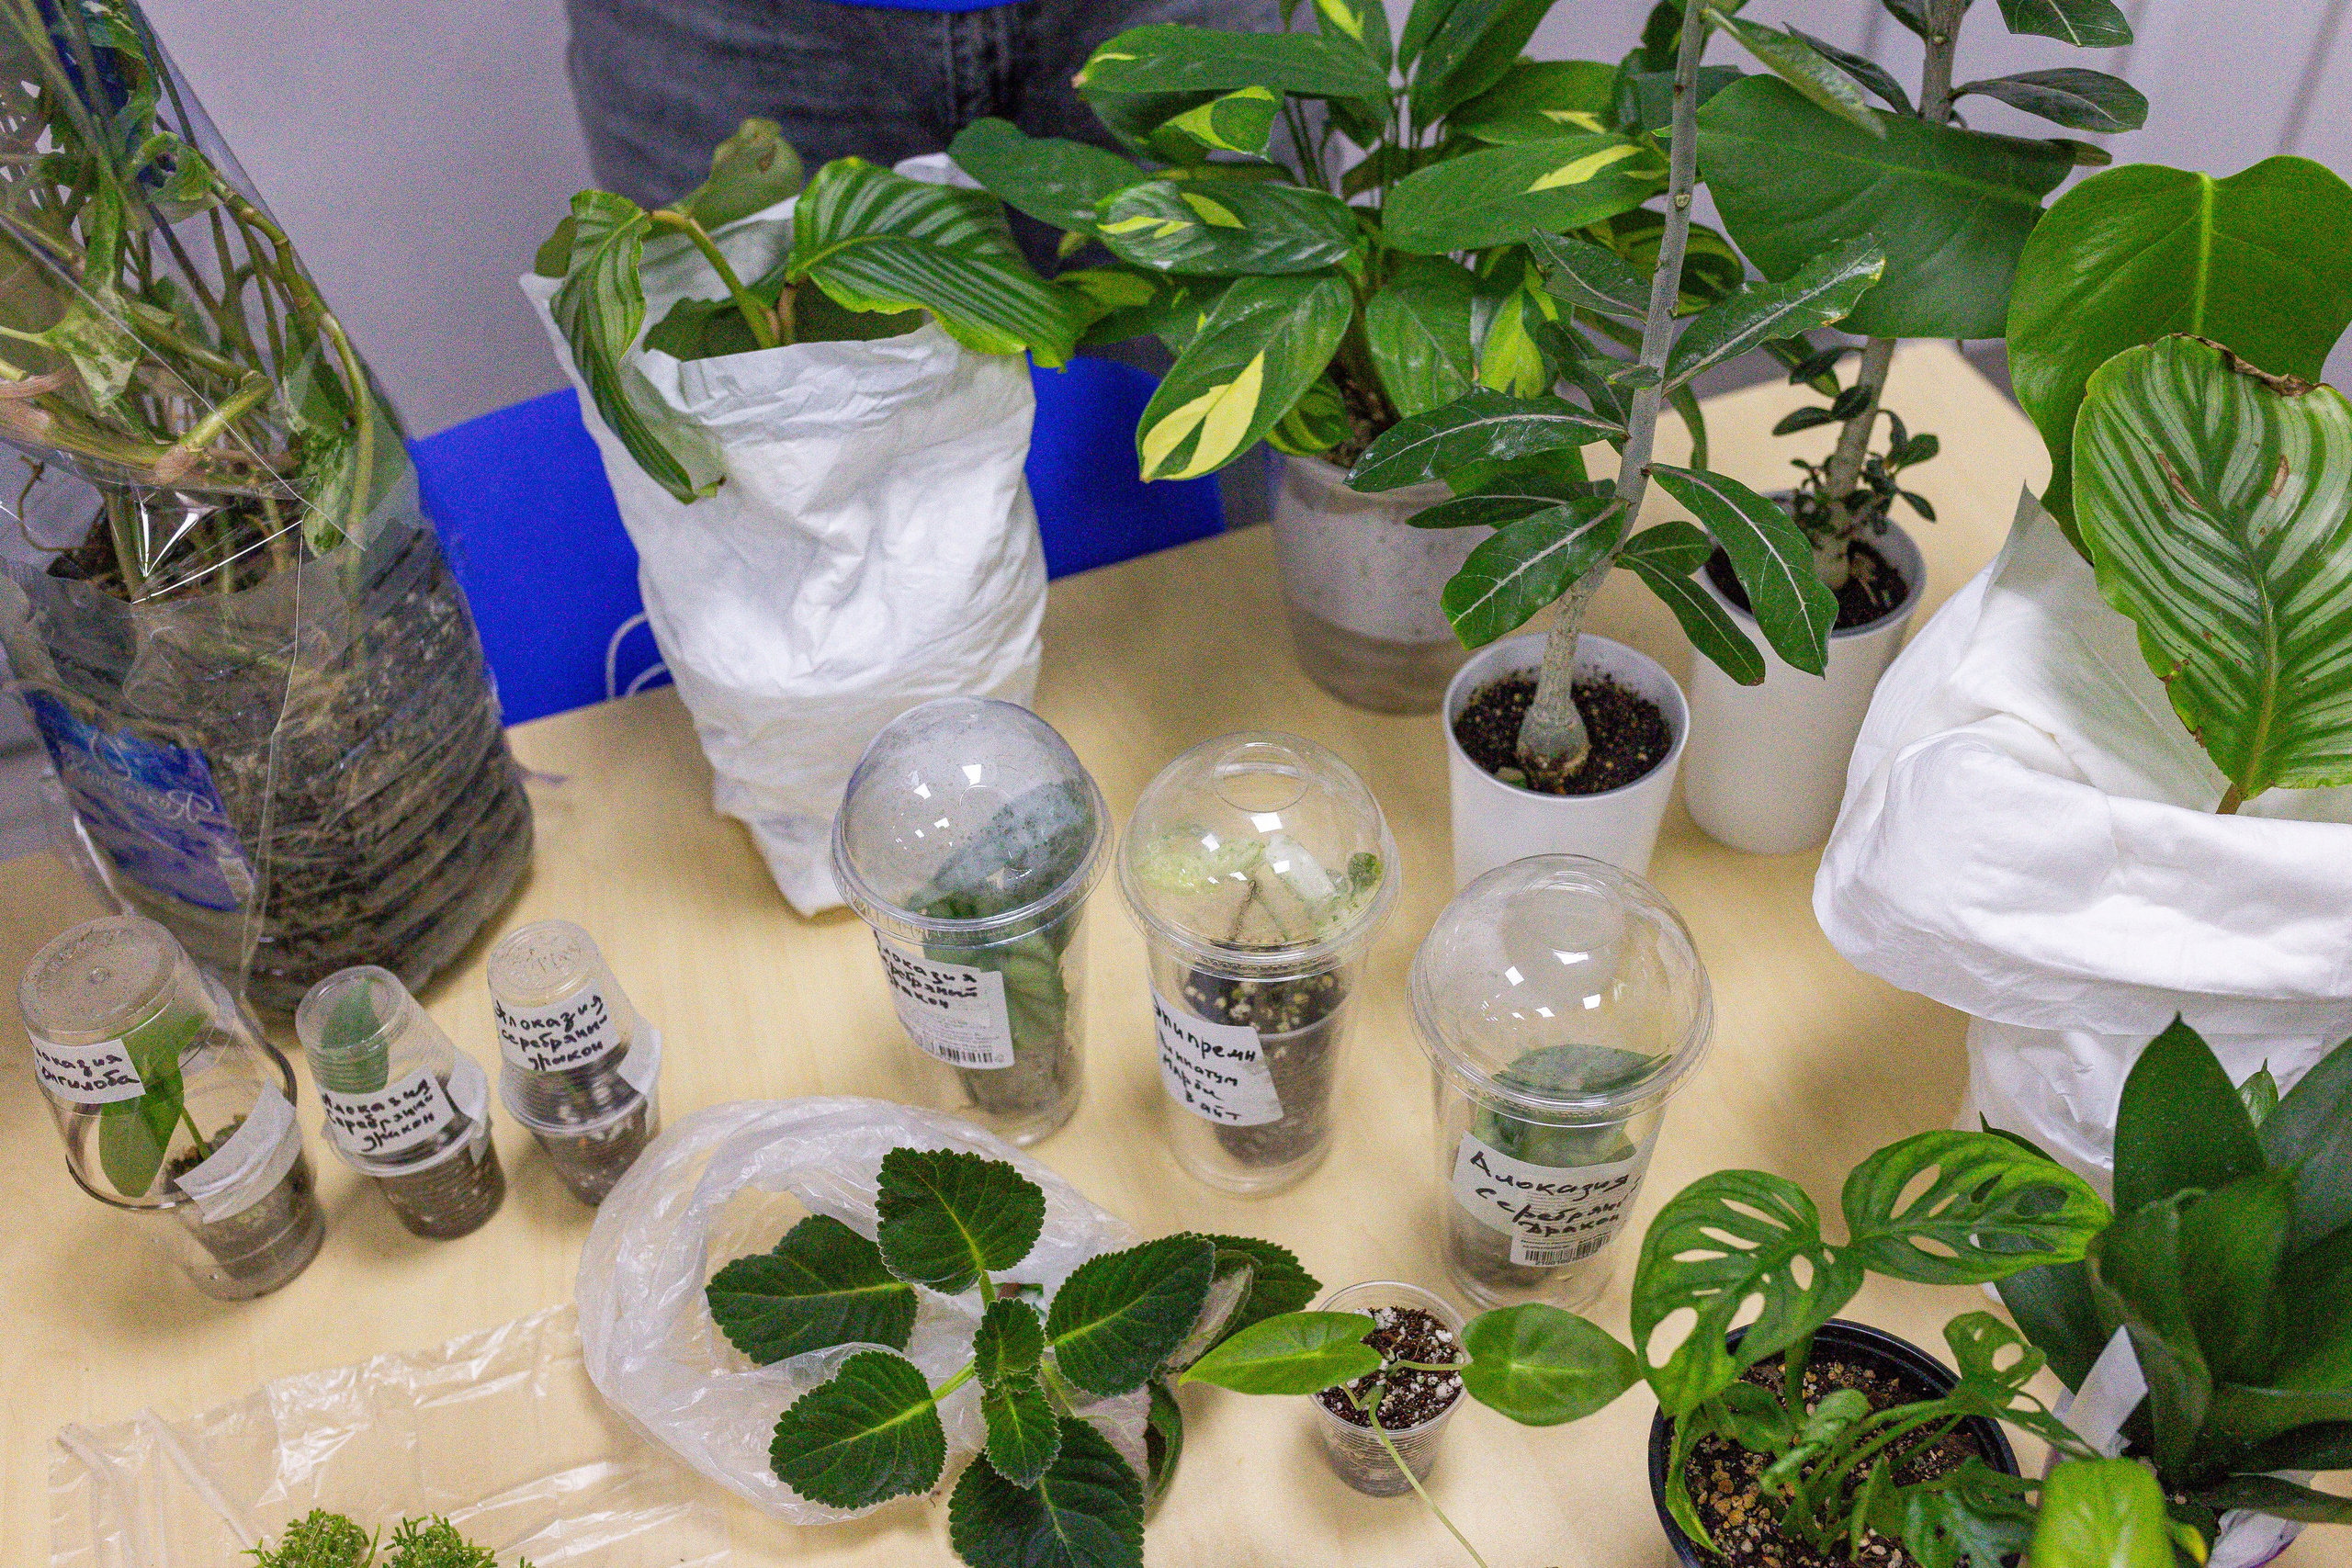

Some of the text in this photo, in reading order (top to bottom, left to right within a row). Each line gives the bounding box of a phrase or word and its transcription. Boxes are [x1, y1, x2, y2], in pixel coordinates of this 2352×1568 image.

[497, 995, 604, 1032] Алоказия
[35, 1046, 123, 1077] оказия
[1470, 1150, 1629, 1201] Алоказия
